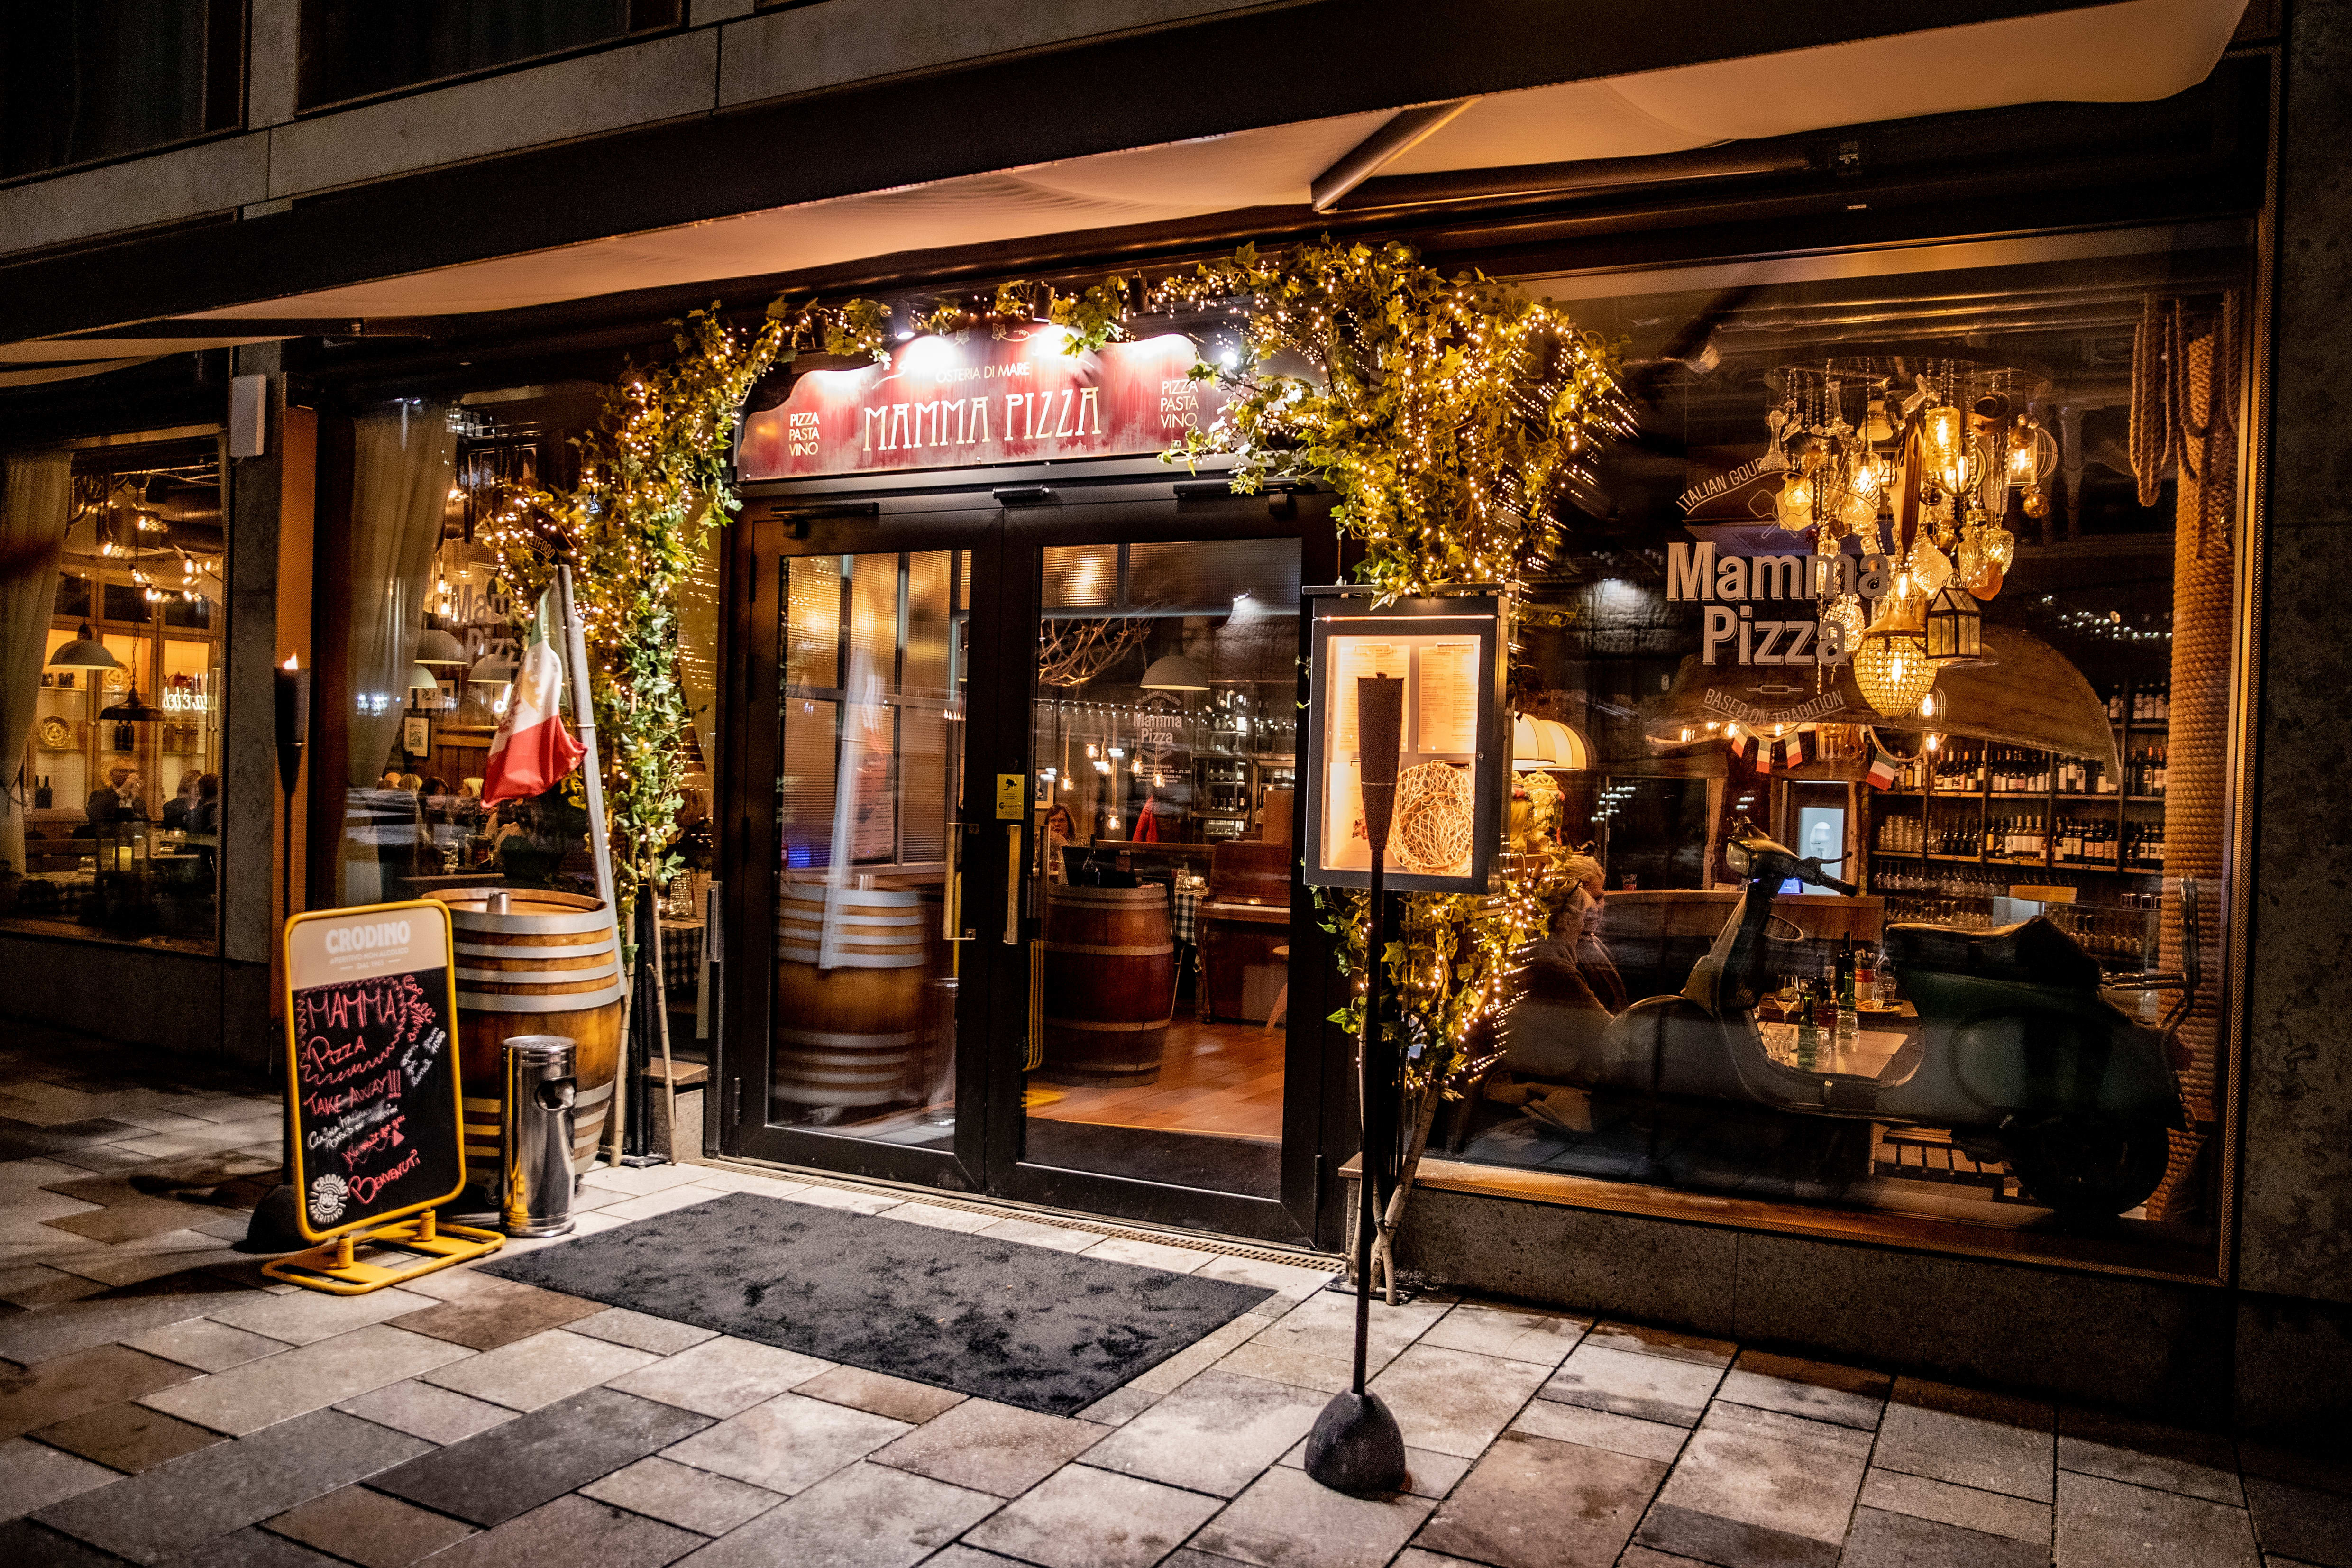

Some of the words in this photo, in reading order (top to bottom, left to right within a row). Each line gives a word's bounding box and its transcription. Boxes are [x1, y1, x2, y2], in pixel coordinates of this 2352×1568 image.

[935, 367, 980, 383] OSTERIA
[984, 365, 995, 378] DI
[998, 362, 1030, 377] MARE
[1162, 379, 1199, 395] PIZZA
[1161, 395, 1199, 412] PASTA
[790, 411, 820, 427] PIZZA
[863, 396, 991, 451] MAMMA
[1004, 386, 1101, 441] PIZZA
[1160, 412, 1197, 429] VINO
[789, 426, 820, 441] PASTA
[789, 441, 819, 456] VINO
[1676, 476, 1727, 511] ITALIAN
[1666, 541, 1891, 602] Mamma
[1702, 605, 1849, 665] Pizza
[1704, 688, 1748, 718] BASED
[1748, 708, 1769, 725] ON
[1772, 690, 1845, 723] TRADITION
[1133, 712, 1182, 728] Mamma
[1141, 728, 1173, 744] Pizza
[326, 920, 411, 954] CRODINO
[306, 986, 397, 1030] MAMMA
[303, 1091, 344, 1116] TAKE
[312, 1174, 349, 1195] CRODINO
[318, 1192, 339, 1206] 1965
